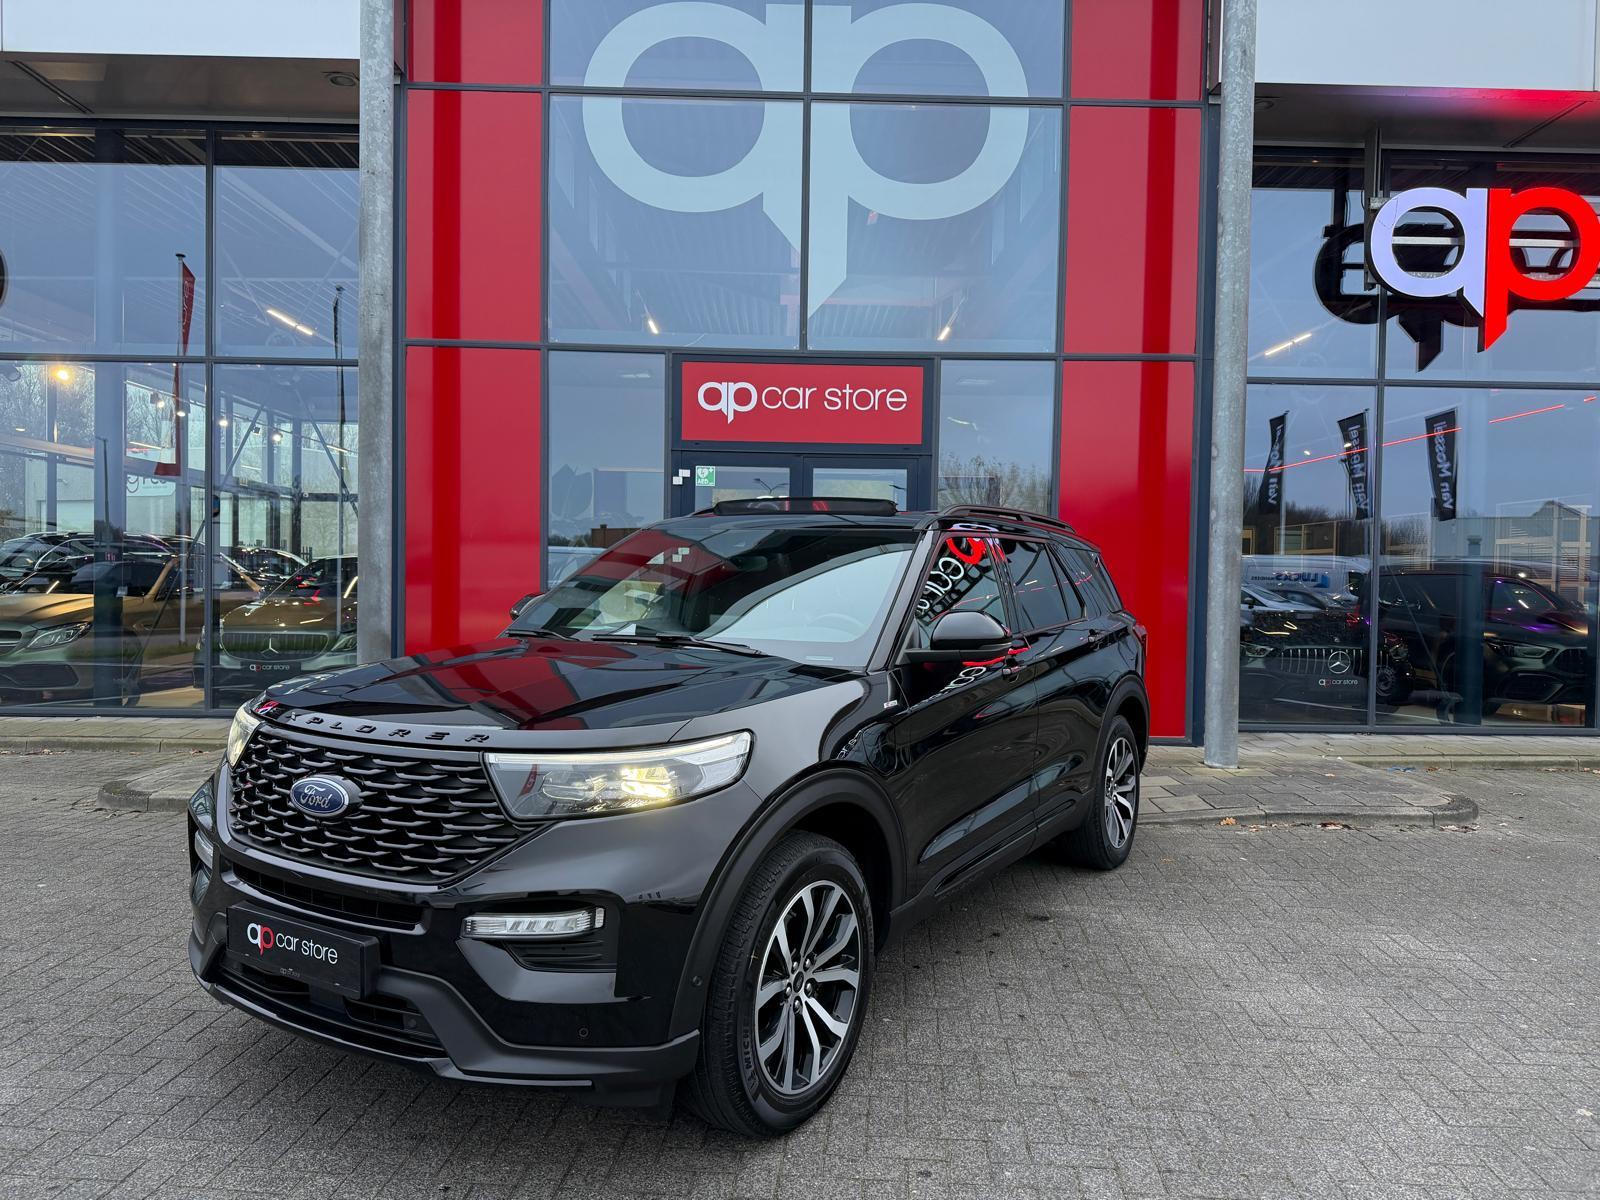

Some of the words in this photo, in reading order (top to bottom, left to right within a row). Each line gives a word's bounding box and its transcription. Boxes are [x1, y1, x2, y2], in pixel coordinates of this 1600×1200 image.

[582, 1, 1030, 317] ap
[1370, 187, 1600, 350] ap
[697, 381, 758, 424] ap
[761, 386, 817, 409] car
[823, 384, 908, 411] store
[300, 784, 332, 809] Ford
[247, 922, 275, 956] ap
[275, 932, 299, 952] car
[300, 939, 338, 964] store
